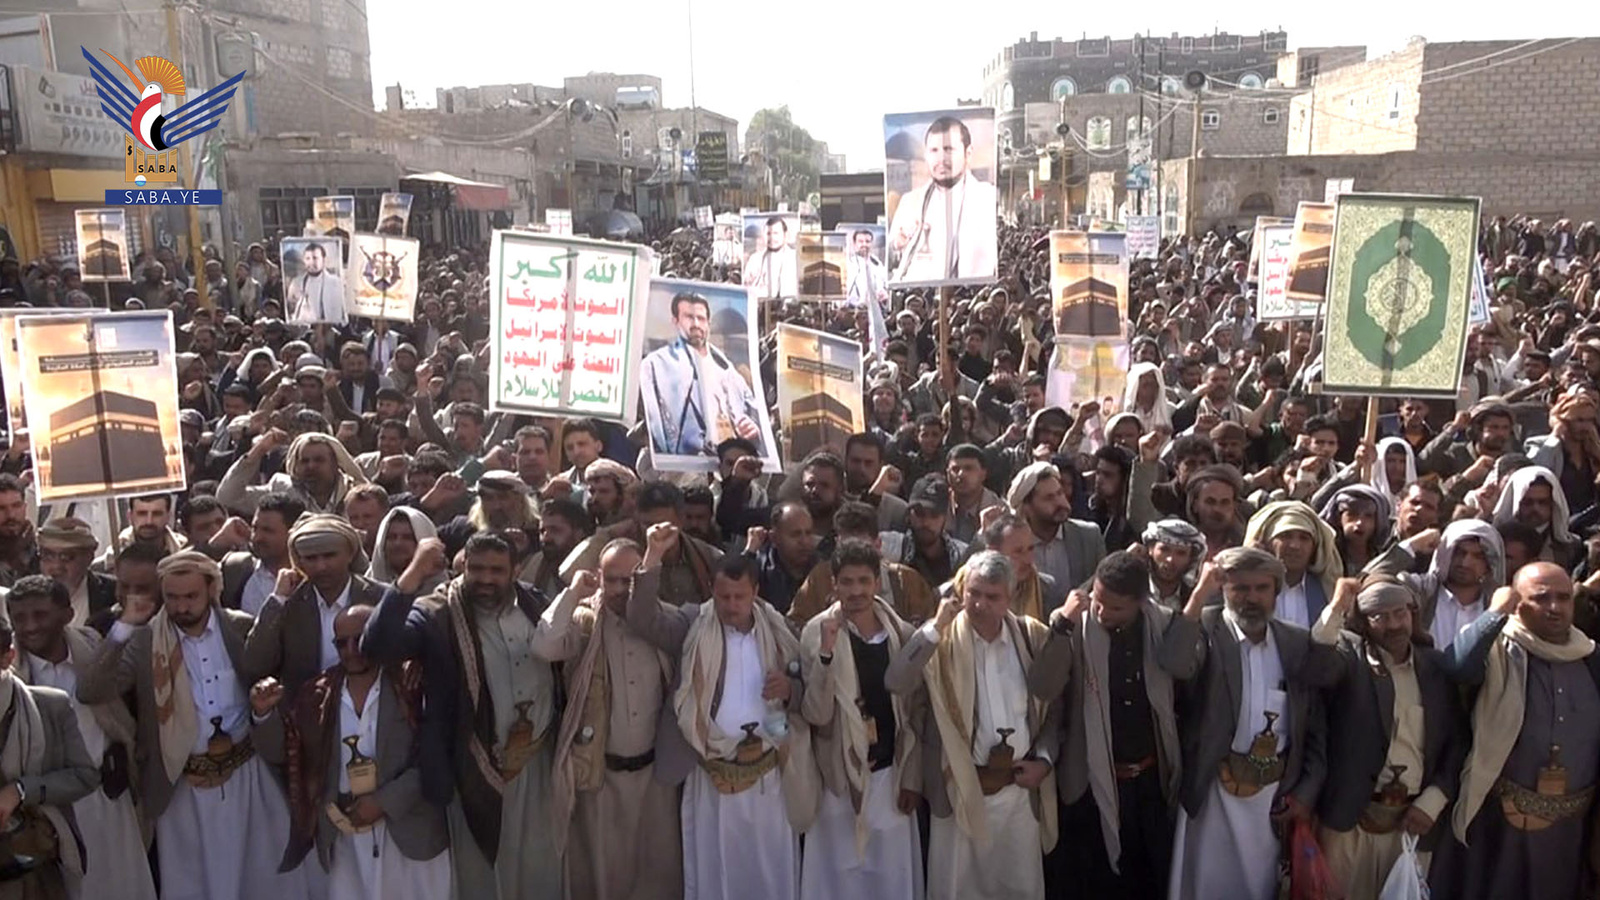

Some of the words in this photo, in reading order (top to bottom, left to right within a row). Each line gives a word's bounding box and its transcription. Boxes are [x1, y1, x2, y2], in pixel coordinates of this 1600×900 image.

[573, 296, 625, 317] الموت
[571, 327, 622, 347] الموت
[504, 350, 547, 371] اليهود
[552, 353, 576, 374] على
[582, 352, 620, 375] اللعنة
[566, 379, 618, 406] النصر
